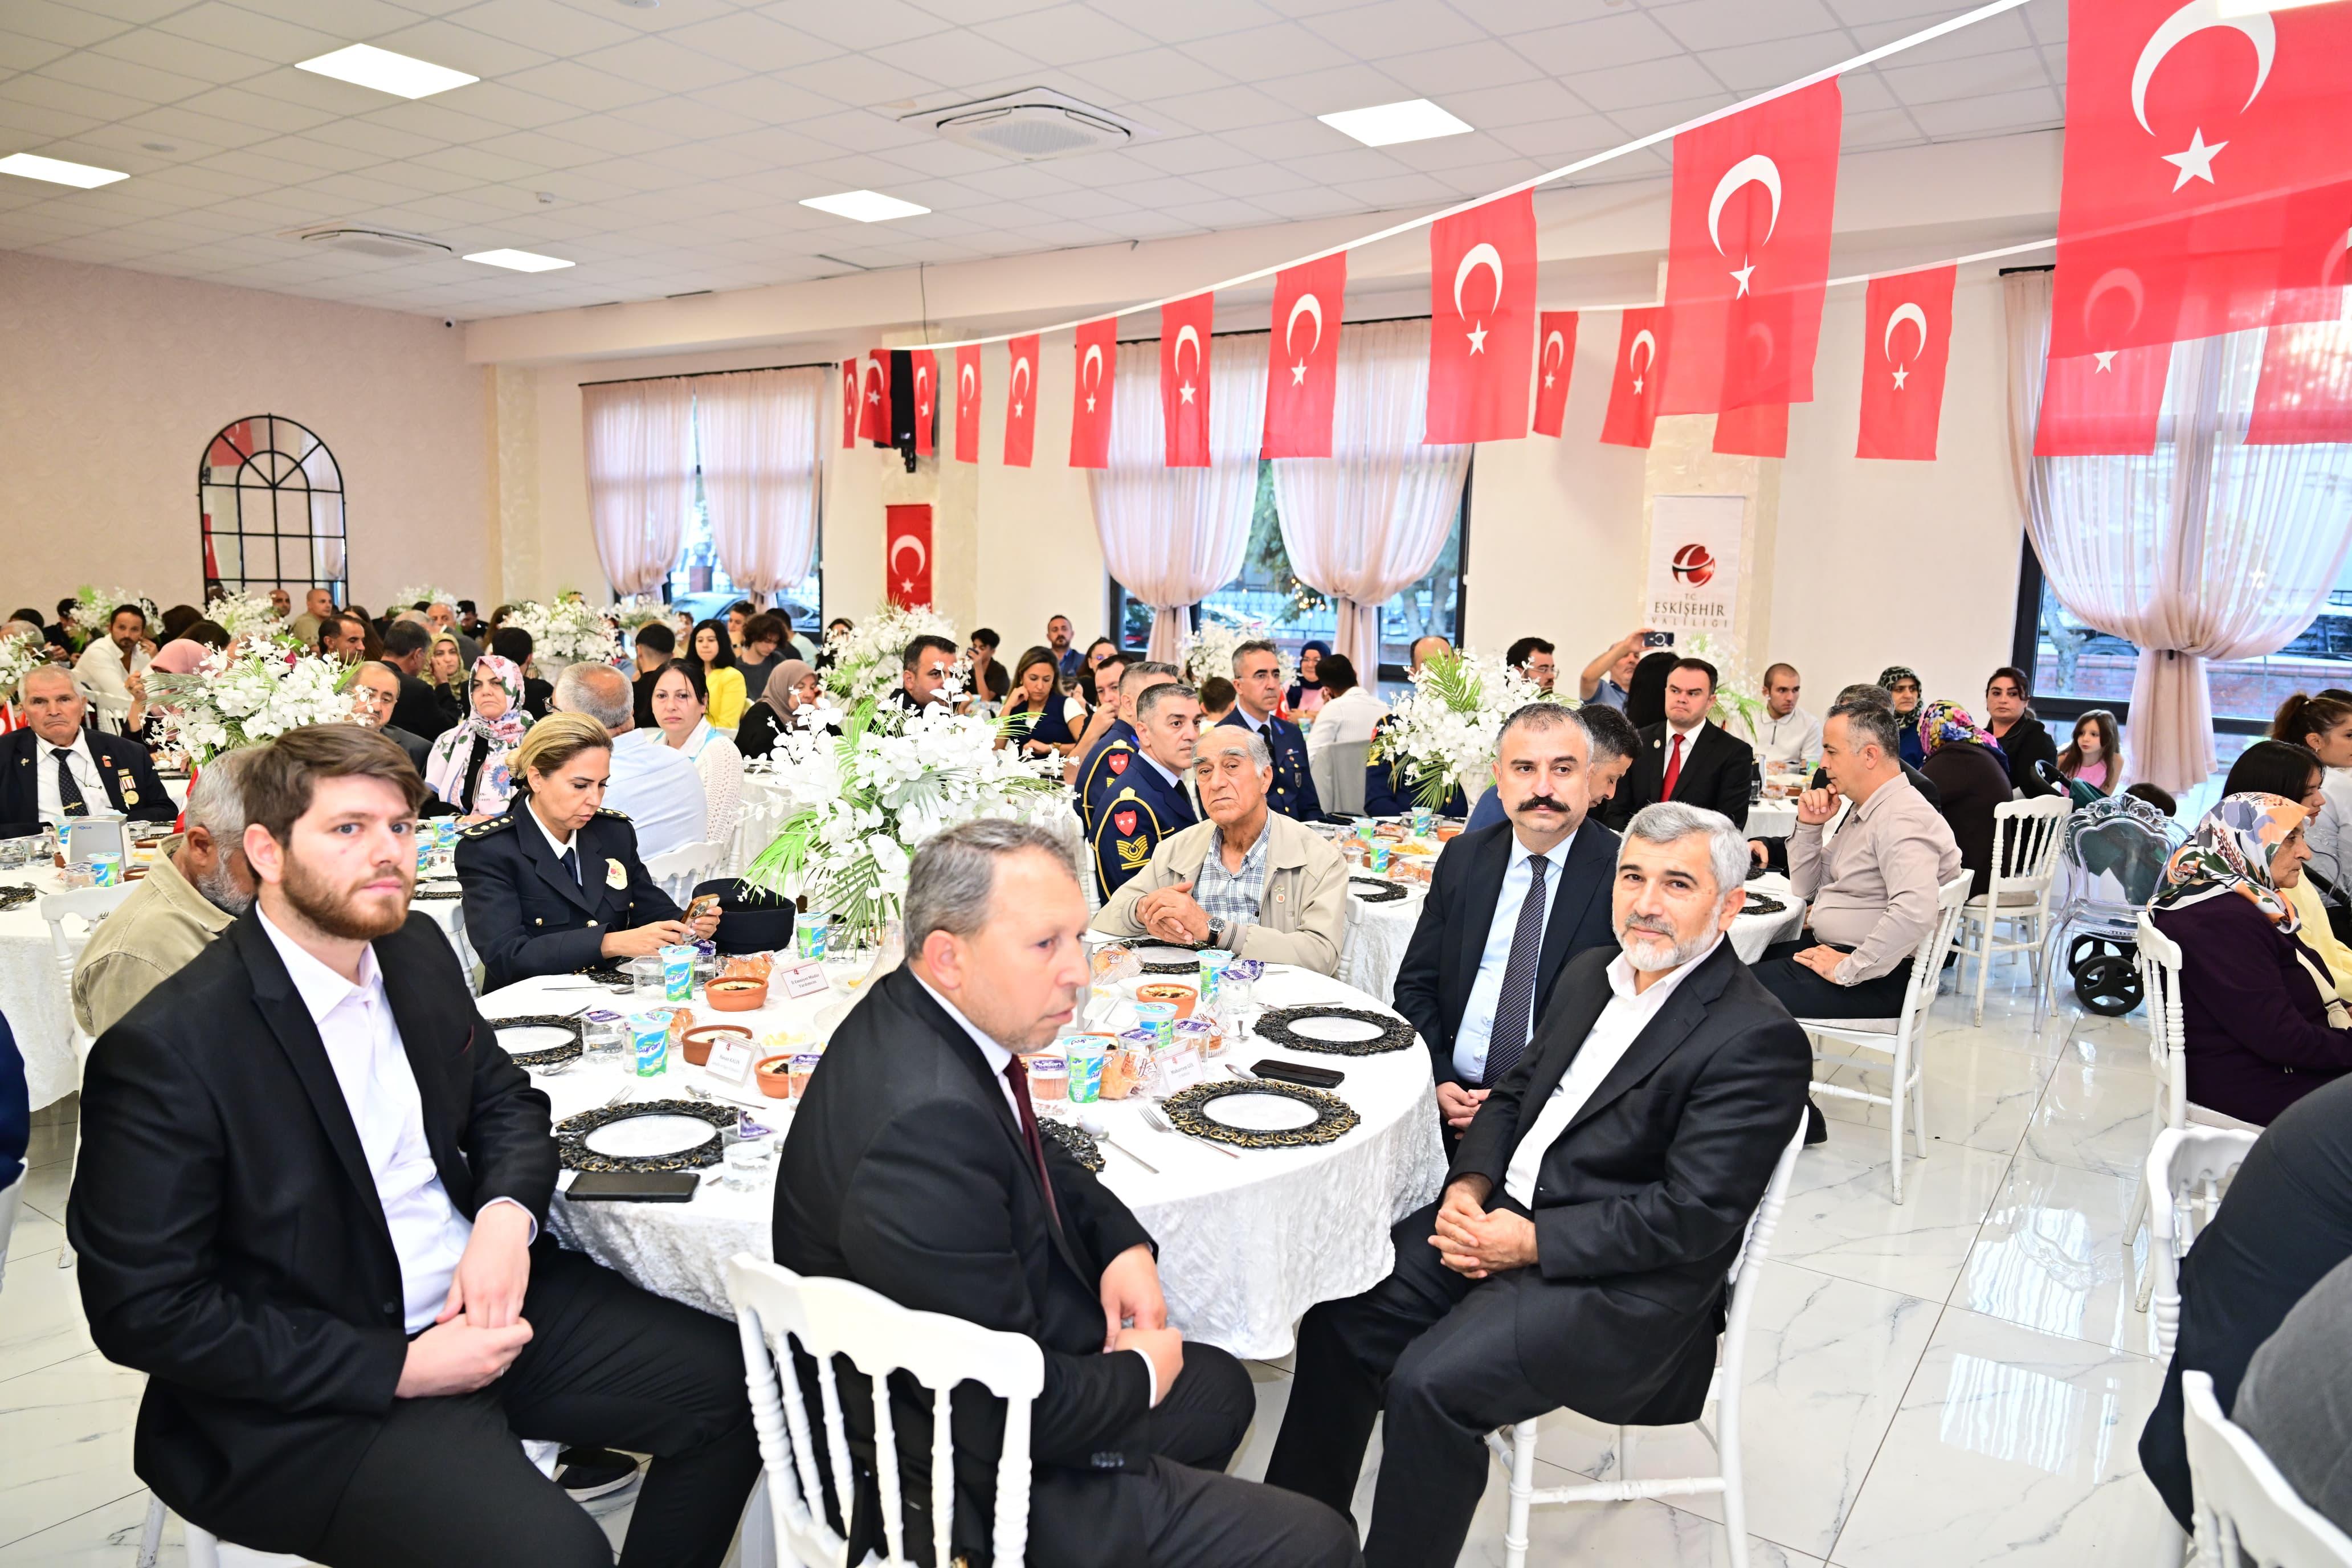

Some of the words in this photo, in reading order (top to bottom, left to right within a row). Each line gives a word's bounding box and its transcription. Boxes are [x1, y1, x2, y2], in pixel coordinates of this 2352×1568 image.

[1655, 600, 1725, 617] ESKİŞEHİR
[667, 972, 685, 982] Ayran
[639, 1042, 661, 1054] Ayran
